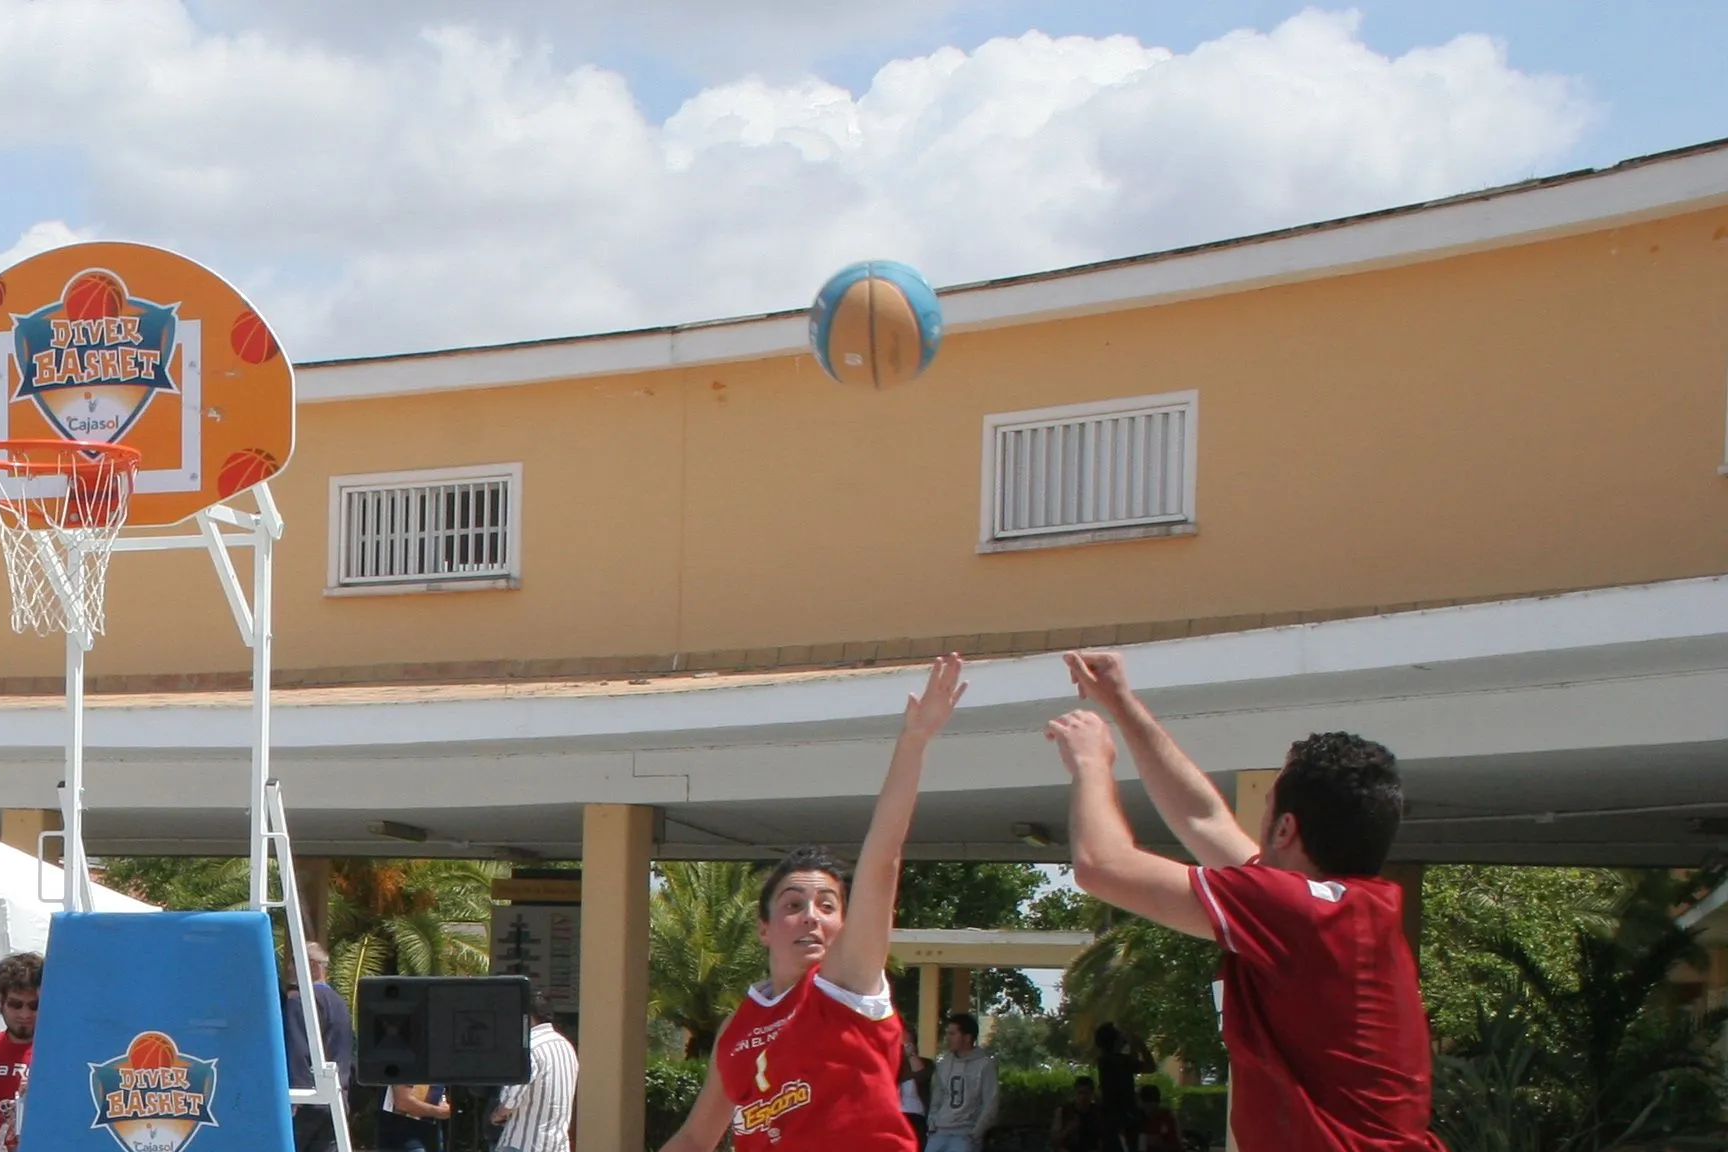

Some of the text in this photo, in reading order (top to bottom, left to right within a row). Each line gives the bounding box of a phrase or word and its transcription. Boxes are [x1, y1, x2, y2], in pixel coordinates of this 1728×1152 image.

[50, 316, 144, 349] DIVER
[32, 347, 161, 387] BASKET
[68, 415, 120, 435] Cajasol
[12, 1062, 30, 1078] R
[119, 1066, 191, 1090] DIVER
[106, 1089, 204, 1118] BASKET
